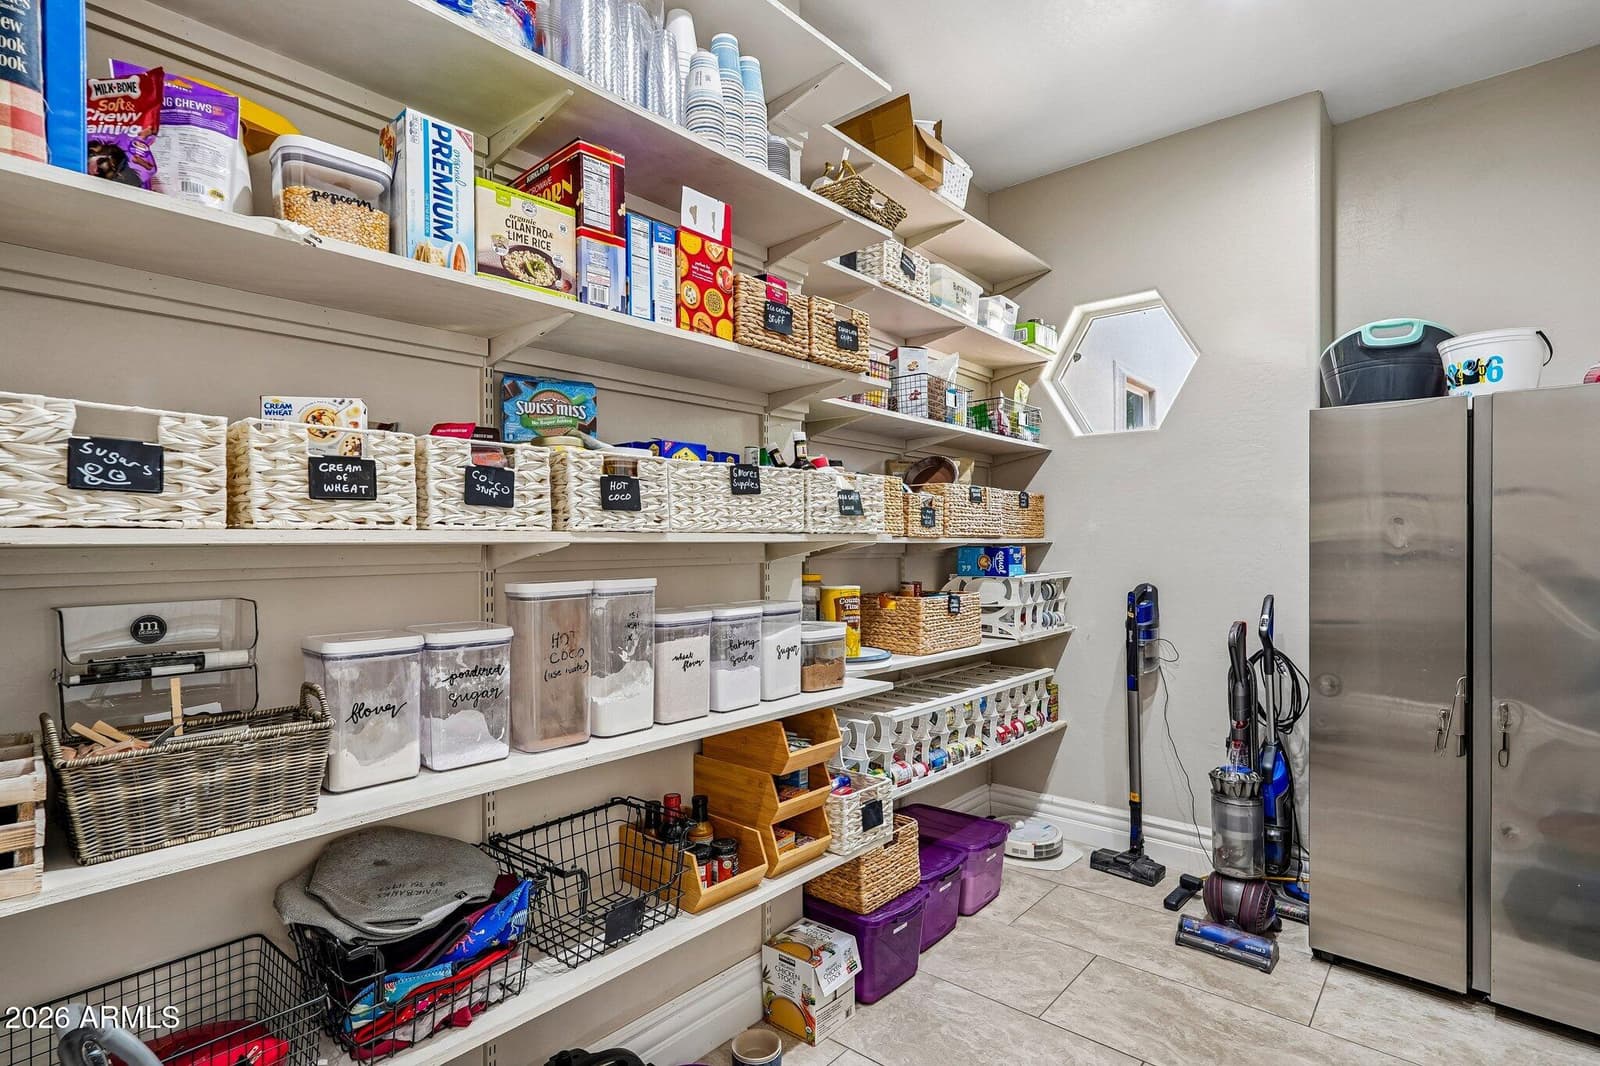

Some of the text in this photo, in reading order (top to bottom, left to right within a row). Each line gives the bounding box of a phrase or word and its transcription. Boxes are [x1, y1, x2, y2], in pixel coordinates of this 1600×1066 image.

[0, 16, 24, 33] ew
[0, 35, 28, 56] ook
[0, 54, 28, 74] ook
[98, 97, 126, 112] Soft
[174, 98, 212, 114] CHEWS
[87, 108, 143, 124] Chewy
[87, 122, 144, 137] aining
[526, 163, 550, 183] KIRKLAND
[431, 122, 454, 243] PREMIUM
[530, 176, 553, 194] ROWAVE
[307, 190, 375, 212] popcorn
[509, 214, 537, 225] organic
[505, 218, 548, 239] CILANTRO
[507, 231, 551, 252] LIME RICE
[264, 402, 293, 410] CREAM
[515, 400, 553, 416] SWISS
[318, 463, 362, 473] CREAM
[324, 483, 369, 495] WHEAT
[610, 481, 629, 491] HOT
[551, 630, 576, 649] HOT
[727, 639, 760, 652] baking
[442, 664, 505, 686] powdered
[448, 688, 504, 708] sugar
[345, 702, 408, 724] flour
[775, 965, 801, 981] CHICKEN
[777, 973, 797, 986] STOCK
[823, 963, 842, 980] CHICKEN
[826, 971, 842, 984] STOCK
